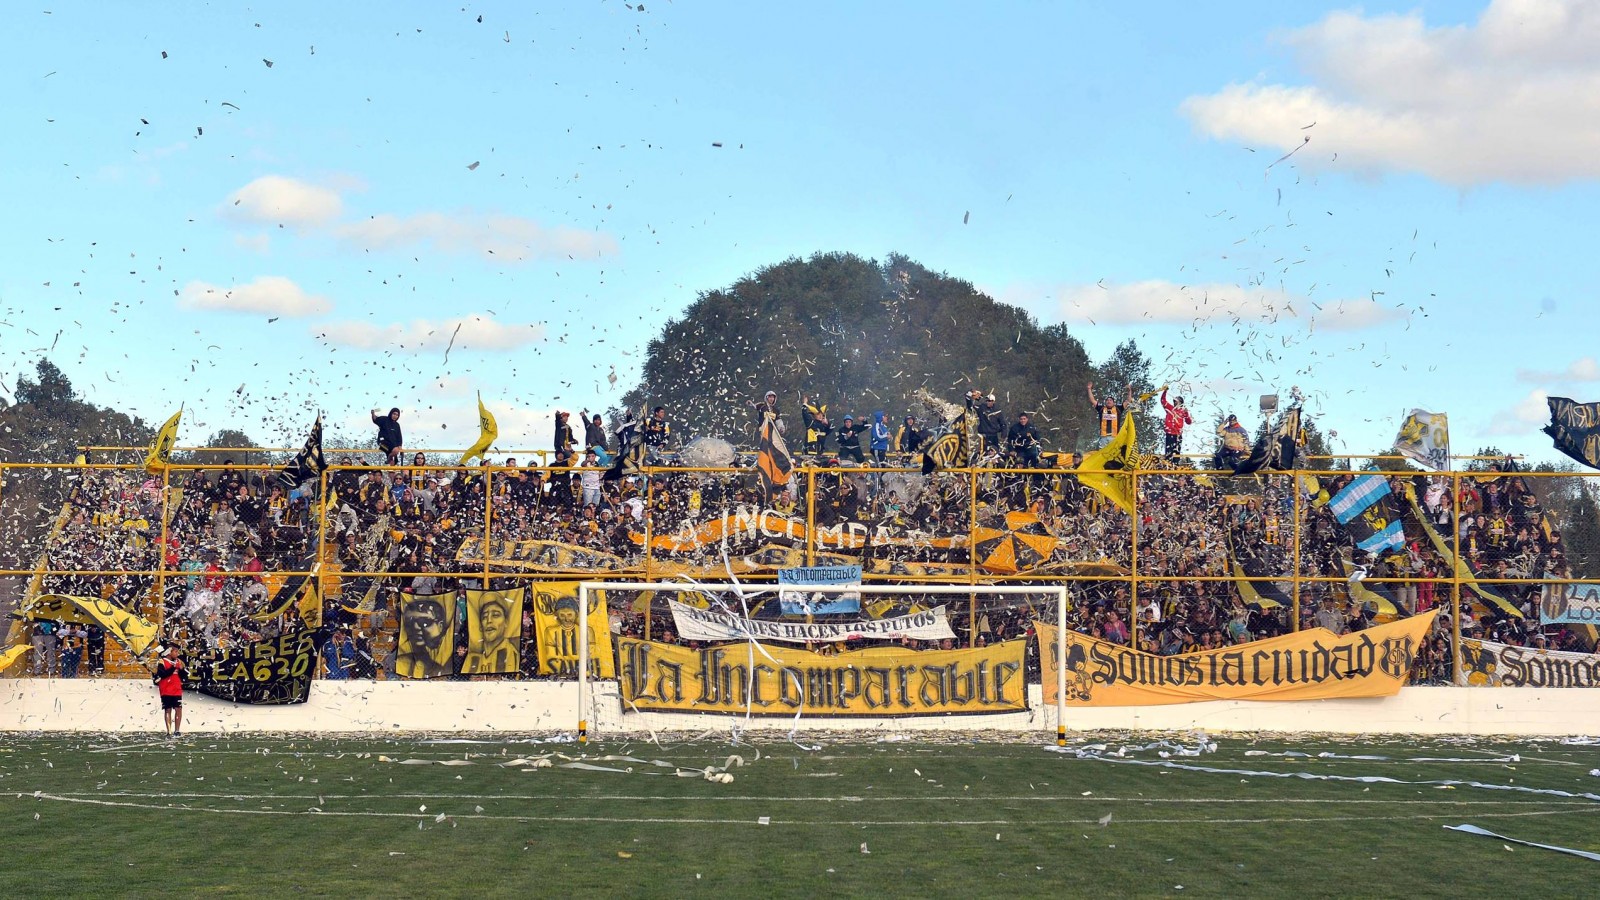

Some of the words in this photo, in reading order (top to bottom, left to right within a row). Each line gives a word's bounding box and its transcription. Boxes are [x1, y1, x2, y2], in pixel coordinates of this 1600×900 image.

[793, 566, 857, 584] Incomparable
[785, 623, 841, 639] HACEN
[881, 608, 936, 633] PUTOS
[622, 641, 685, 704] La
[693, 648, 1021, 712] Incomparable
[1090, 641, 1202, 687] Somos
[1251, 633, 1378, 687] ciudad
